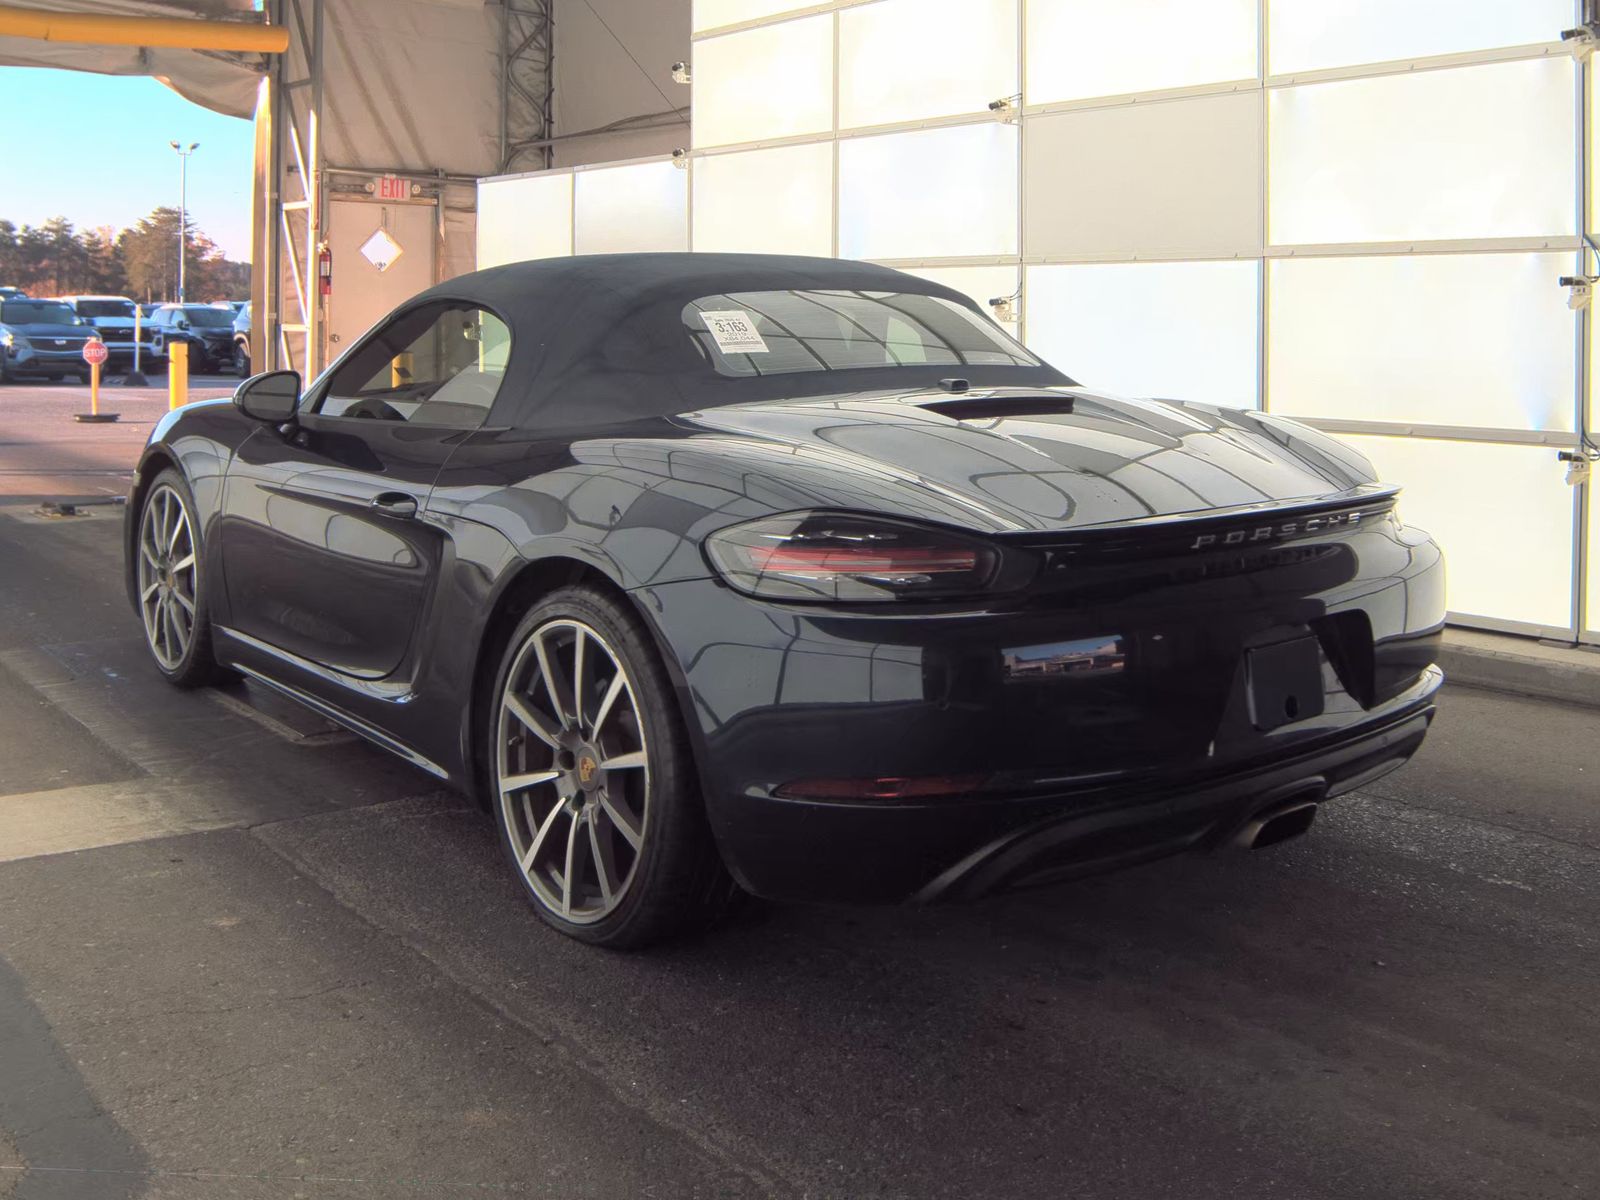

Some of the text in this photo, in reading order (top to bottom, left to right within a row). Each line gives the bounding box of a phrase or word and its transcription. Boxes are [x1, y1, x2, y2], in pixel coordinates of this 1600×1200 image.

[381, 176, 405, 198] EXIT
[84, 348, 106, 357] STOP
[1191, 513, 1362, 549] PORSCHE
